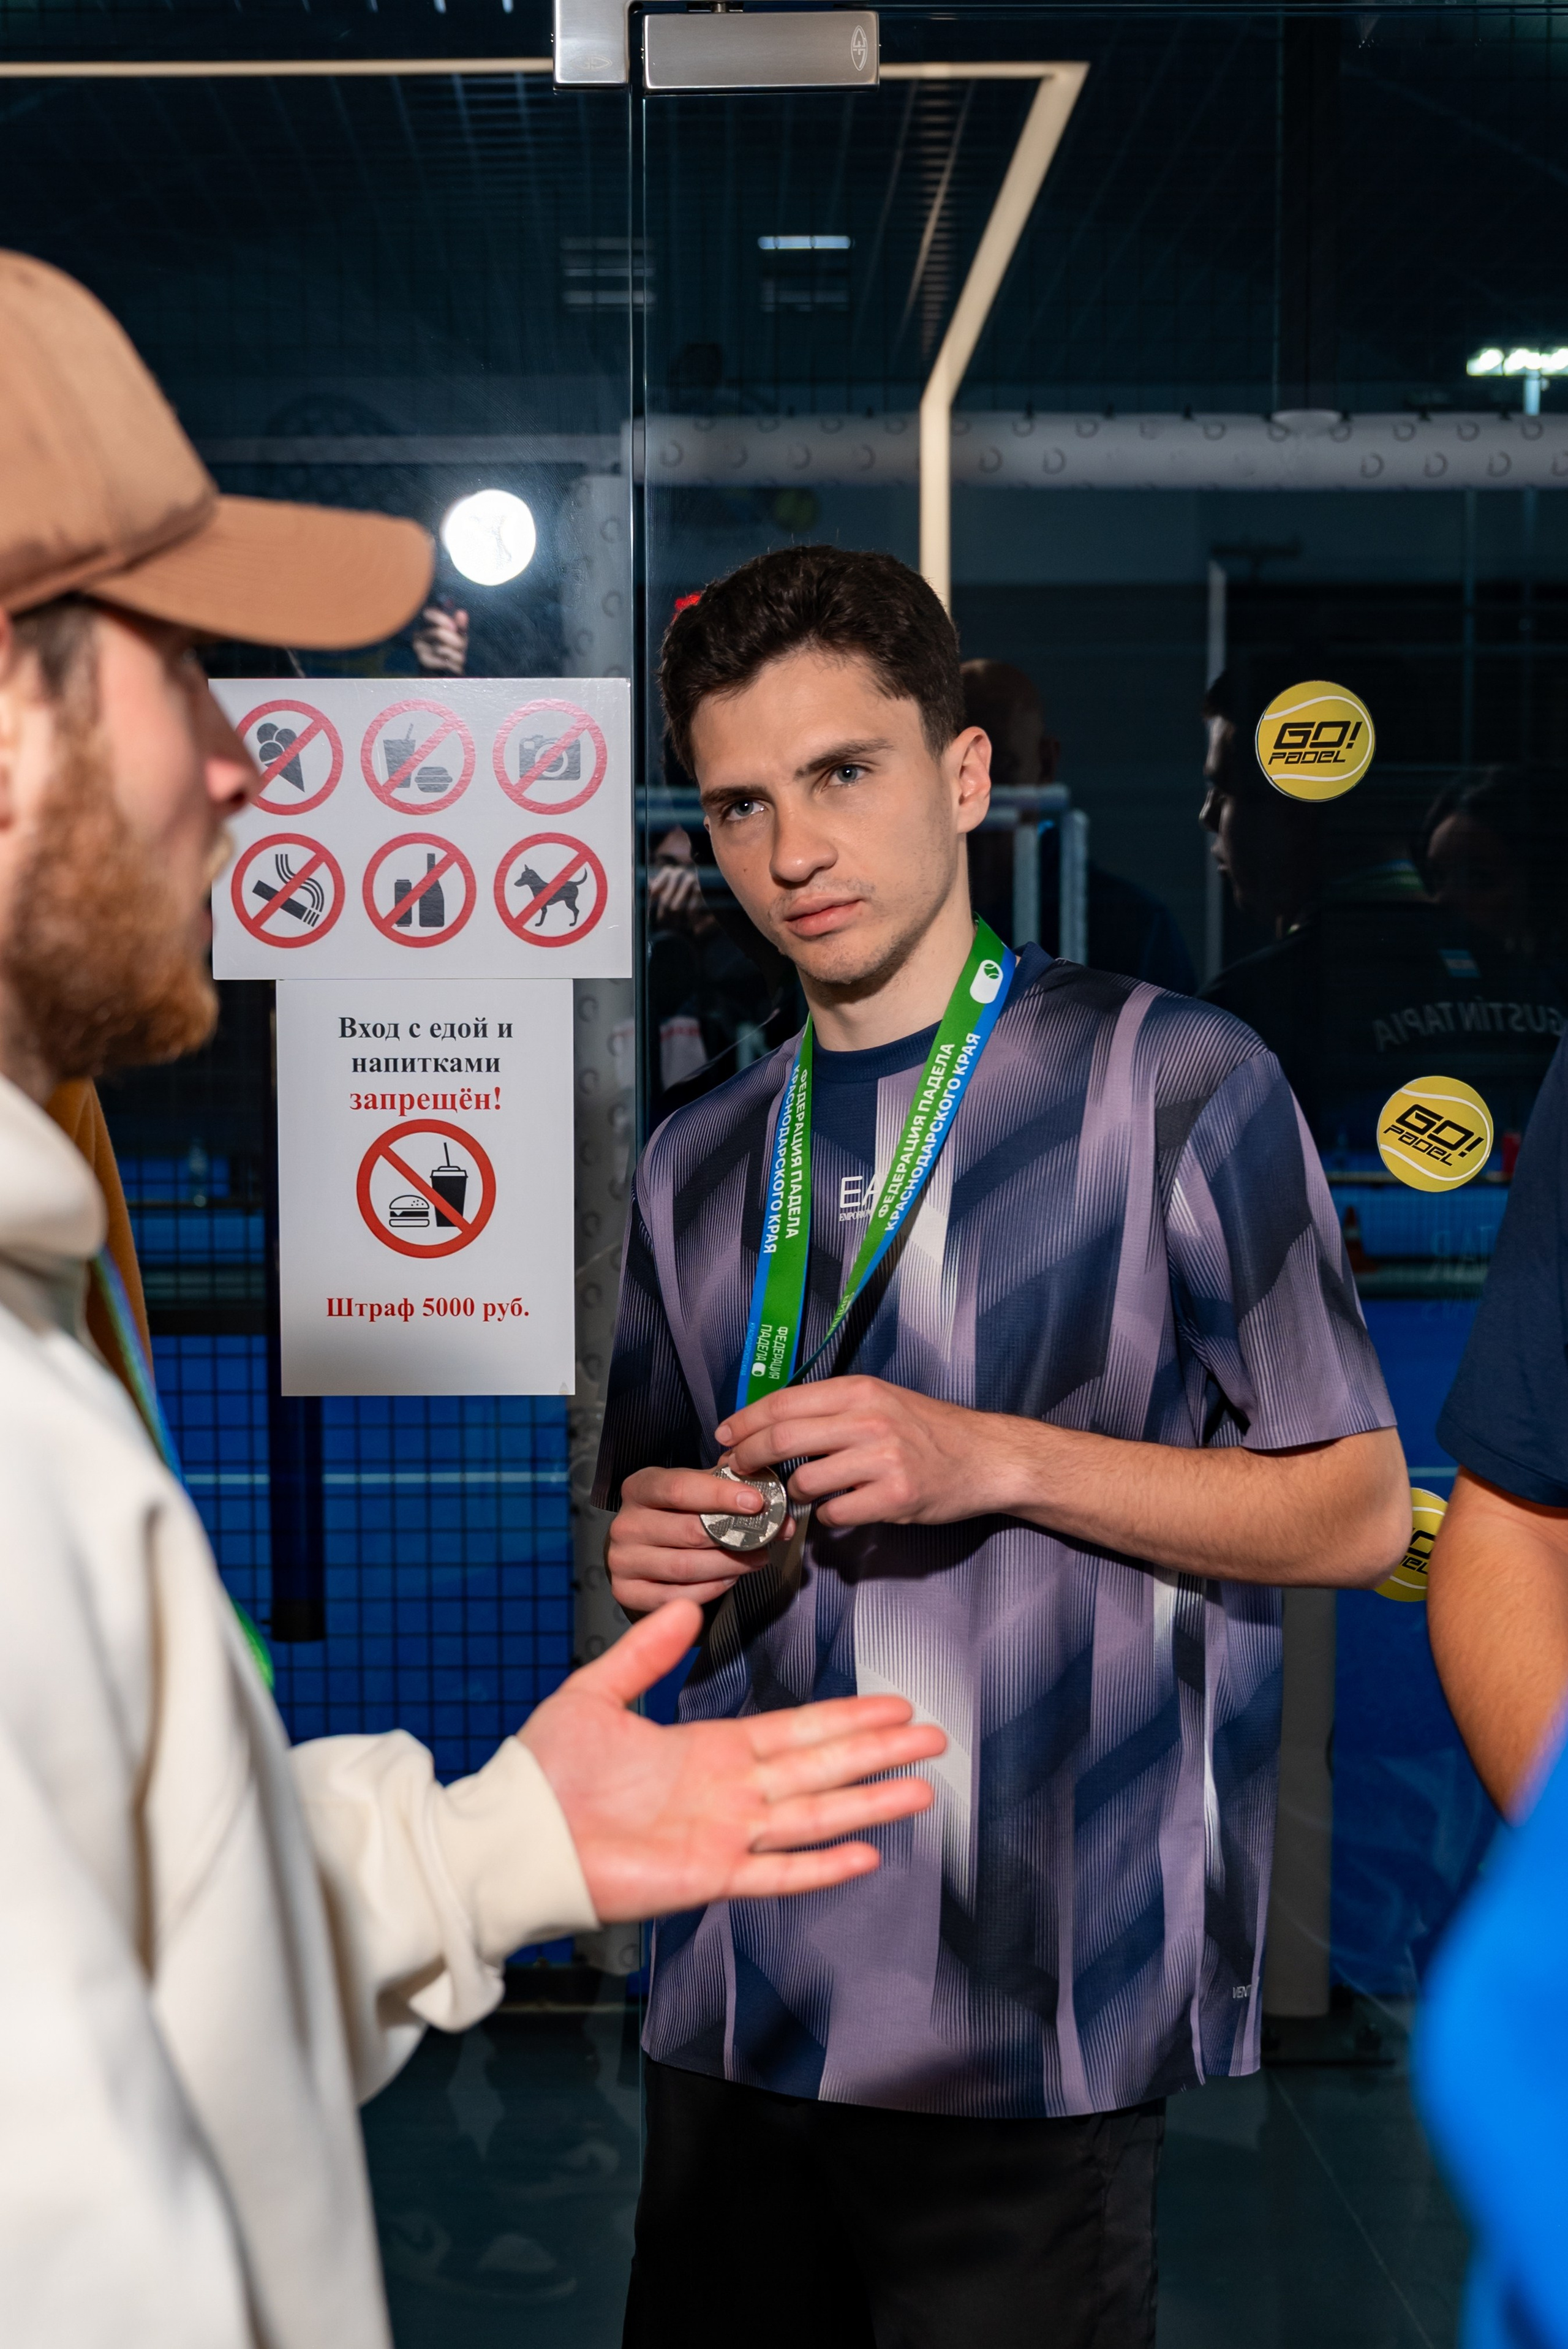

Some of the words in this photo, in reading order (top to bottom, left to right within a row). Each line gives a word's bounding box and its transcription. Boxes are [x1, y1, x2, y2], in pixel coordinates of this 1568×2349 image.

[1273, 720, 1363, 750] GO!
[338, 1016, 400, 1041] Вход
[409, 1022, 421, 1038] с
[429, 1017, 489, 1041] едой
[497, 1022, 513, 1038] и
[351, 1057, 501, 1073] напитками
[349, 1087, 502, 1117] запрещён!
[790, 1068, 809, 1167] ФЕДЕРАЦИЯ
[770, 1064, 800, 1211] КРАСНОДАРСКОГО
[878, 1115, 927, 1218] ФЕДЕРАЦИЯ
[918, 1043, 956, 1112] ПАДЕЛА
[884, 1078, 961, 1232] КРАСНОДАРСКОГО
[952, 1033, 981, 1076] КРАЯ
[1395, 1104, 1485, 1158] GO!
[785, 1170, 802, 1239] ПАДЕЛА
[840, 1174, 880, 1208] EA
[763, 1213, 782, 1254] КРАЯ
[326, 1297, 415, 1322] Штраф
[421, 1297, 475, 1317] 5000
[481, 1297, 529, 1322] руб.
[755, 1324, 772, 1361] ПАДЕЛА
[768, 1326, 788, 1379] ФЕДЕРАЦИЯ
